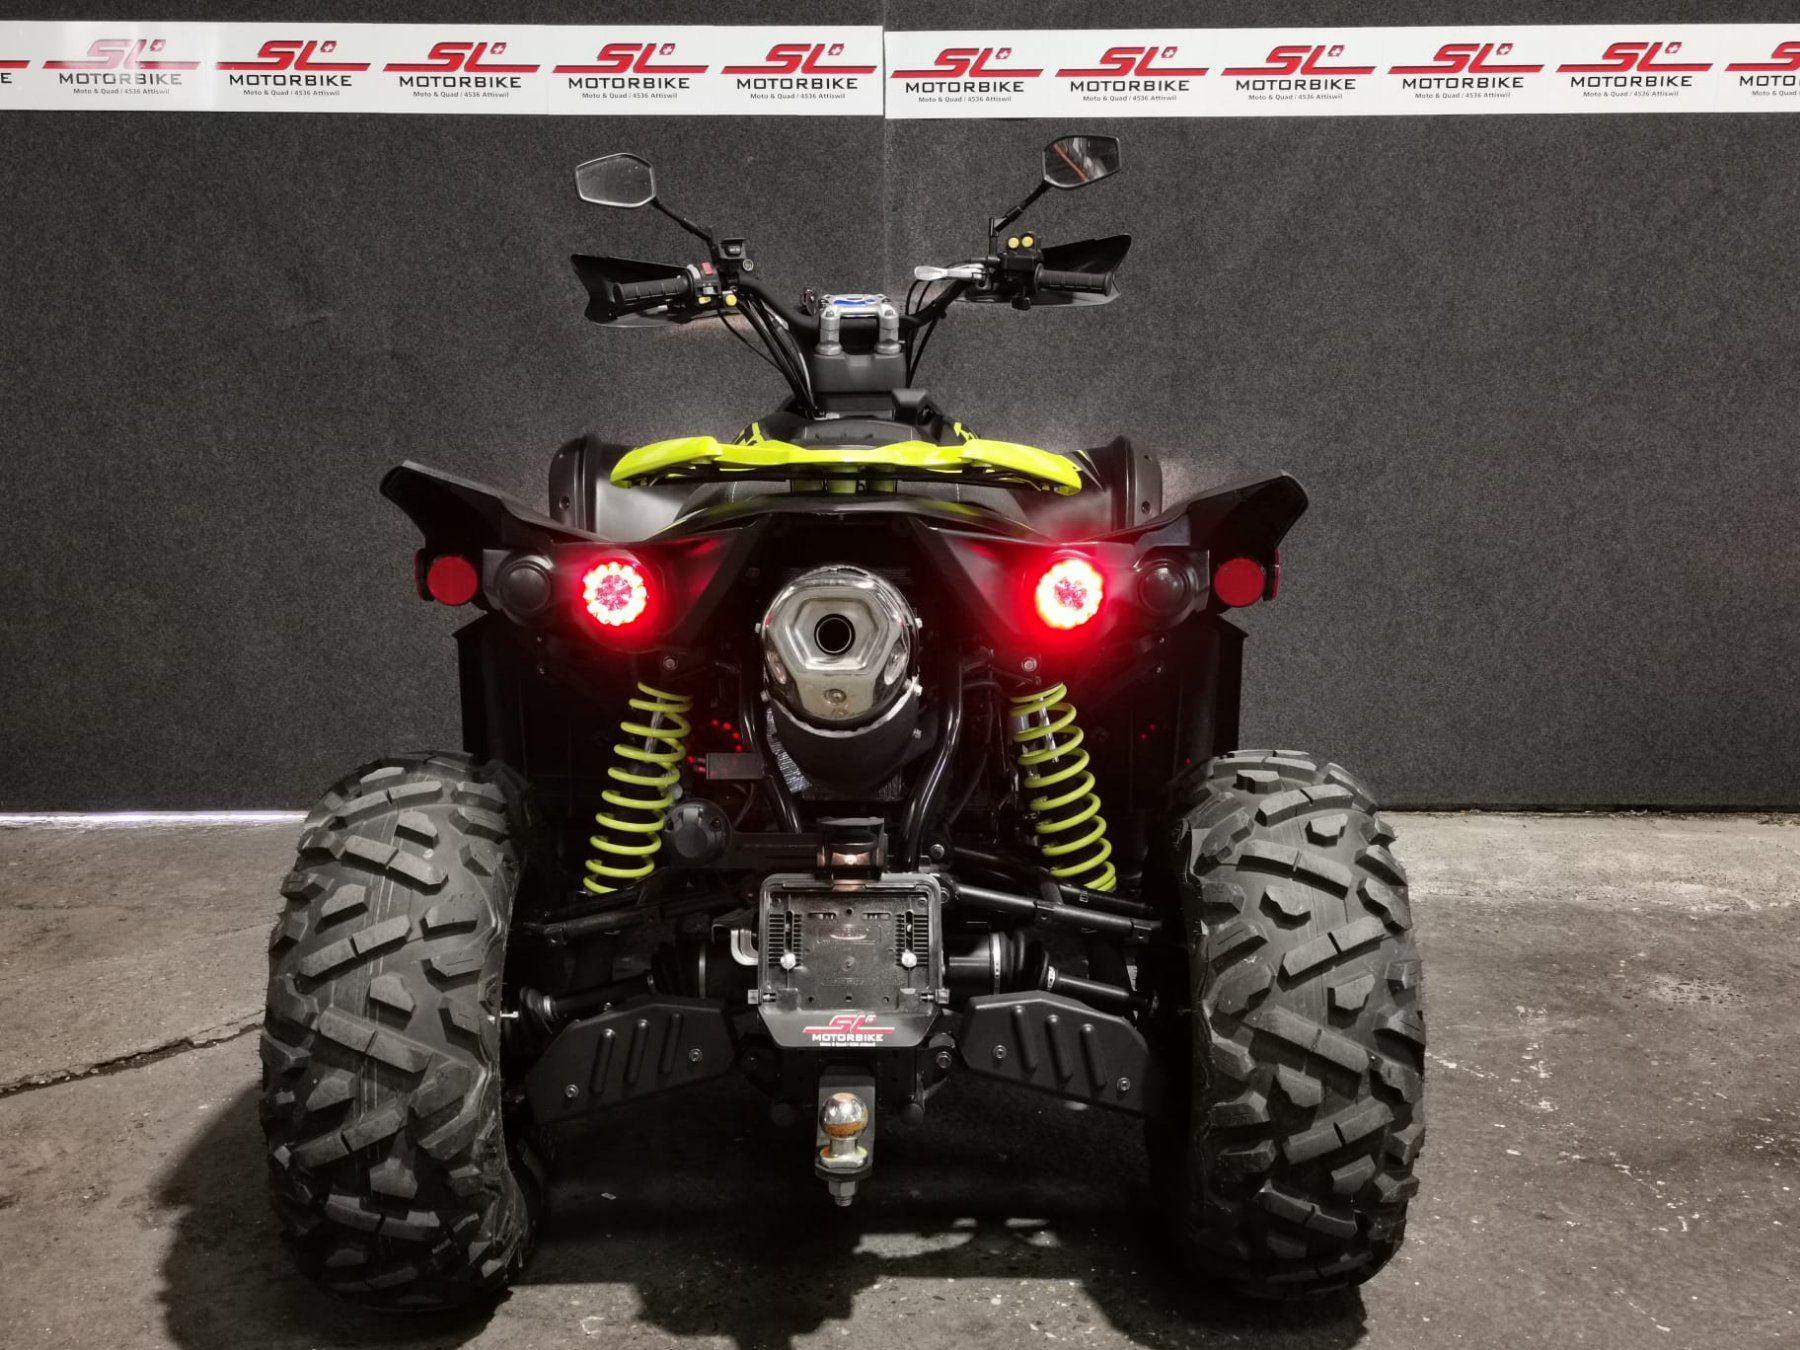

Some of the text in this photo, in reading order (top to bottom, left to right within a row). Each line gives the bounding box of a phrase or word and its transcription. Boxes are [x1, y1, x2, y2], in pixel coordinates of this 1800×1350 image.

[59, 73, 181, 85] MOTORBIKE
[230, 75, 352, 86] MOTORBIKE
[399, 76, 521, 88] MOTORBIKE
[569, 78, 689, 89] MOTORBIKE
[737, 78, 858, 89] MOTORBIKE
[1236, 79, 1356, 90] MOTORBIKE
[1403, 77, 1523, 89] MOTORBIKE
[1571, 76, 1692, 87] MOTORBIKE
[906, 81, 1024, 93] MOTORBIKE
[1071, 80, 1189, 92] MOTORBIKE
[811, 1033, 884, 1042] MOTORBIKE
